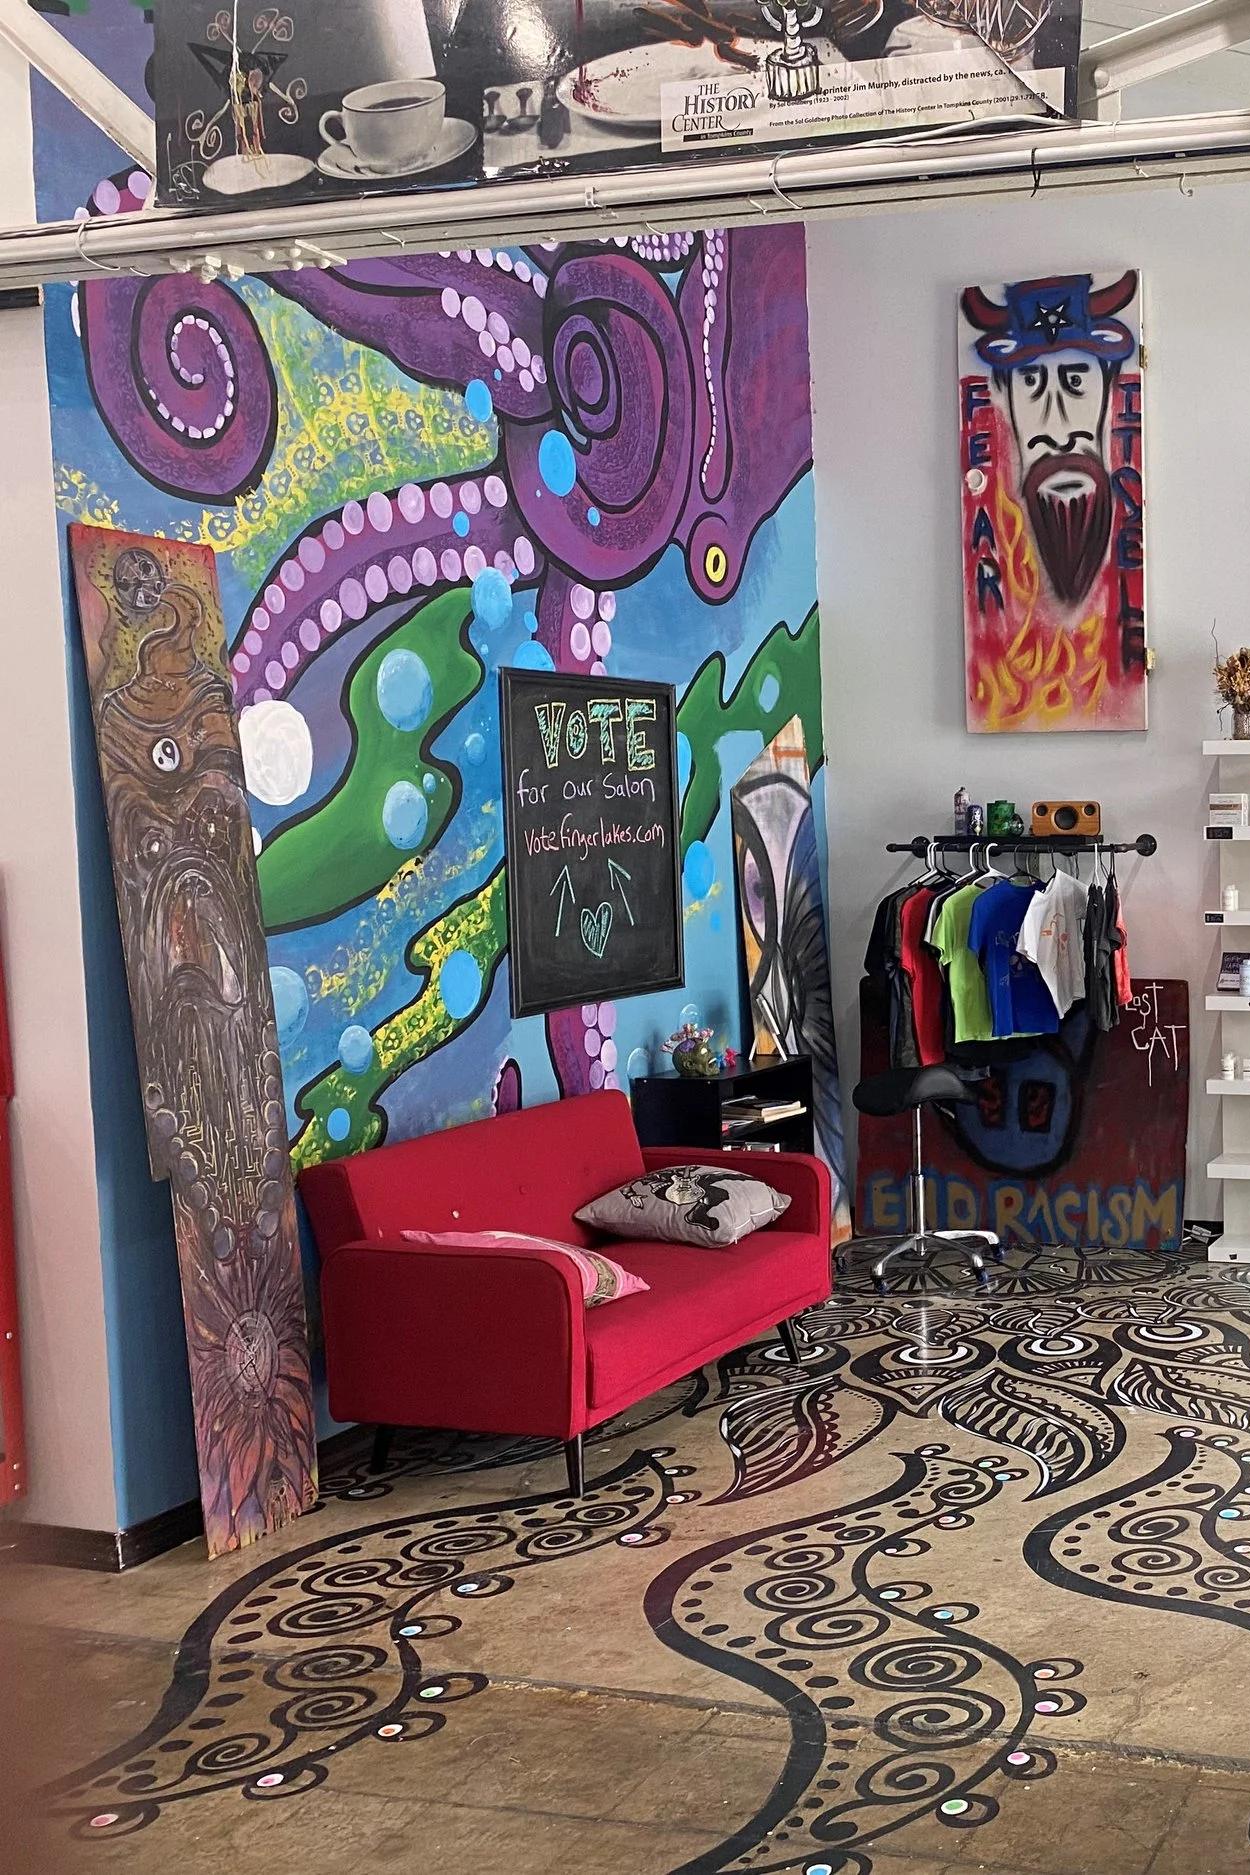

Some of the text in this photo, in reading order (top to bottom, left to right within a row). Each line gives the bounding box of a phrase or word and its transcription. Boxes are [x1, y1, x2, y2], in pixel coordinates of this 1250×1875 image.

[698, 83, 720, 96] THE
[852, 82, 867, 93] Jim
[868, 79, 901, 92] Murphy,
[901, 74, 942, 86] distracted
[943, 72, 954, 83] by
[955, 70, 969, 80] the
[970, 69, 993, 80] news,
[994, 68, 1006, 76] ca.
[684, 90, 760, 116] HISTORY
[769, 102, 776, 110] By
[777, 100, 786, 108] Sol
[804, 116, 831, 124] Goldberg
[831, 113, 848, 121] Photo
[849, 110, 877, 119] Collection
[884, 107, 895, 115] The
[895, 106, 916, 115] History
[917, 104, 936, 112] Center
[943, 101, 971, 110] Tompkins
[972, 98, 993, 107] County
[672, 113, 728, 133] CENTER
[535, 698, 657, 770] VOTE
[517, 768, 656, 807] for our Salon
[1131, 1024, 1187, 1087] CAT
[994, 1183, 1178, 1249] RACISM
